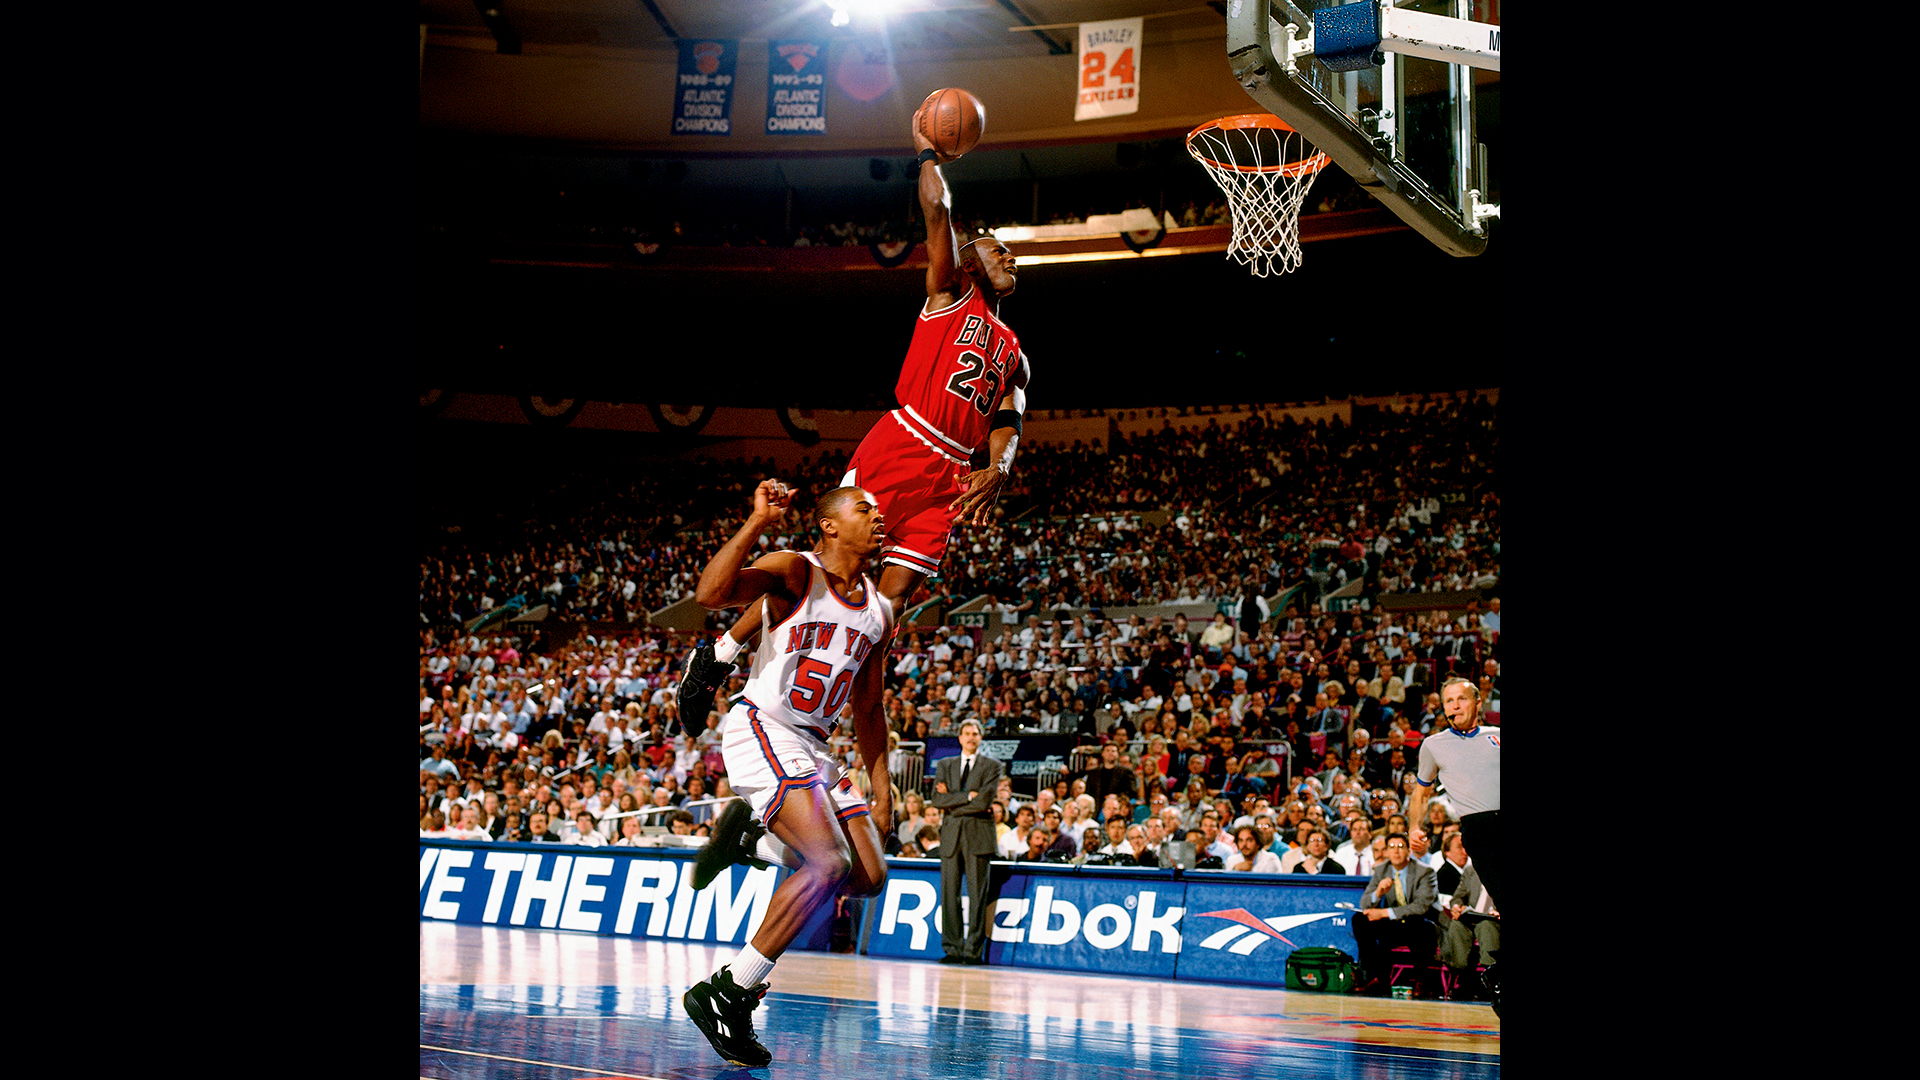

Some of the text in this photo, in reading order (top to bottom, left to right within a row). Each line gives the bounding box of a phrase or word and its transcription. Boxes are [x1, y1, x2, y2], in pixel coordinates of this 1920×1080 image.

[1087, 28, 1133, 47] BRADLEY
[1083, 47, 1135, 88] 24
[683, 89, 726, 103] ATLANTIC
[774, 89, 820, 103] ATLANTIC
[684, 103, 723, 117] DIVISION
[776, 103, 818, 117] DIVISION
[675, 117, 729, 133] CHAMPIONS
[767, 116, 826, 132] CHAMPIONS
[945, 350, 1001, 417] 23
[785, 621, 838, 655] NEW
[788, 654, 853, 719] 50
[482, 851, 615, 932] THE
[614, 859, 778, 943] RIM
[1331, 917, 1347, 927] TM
